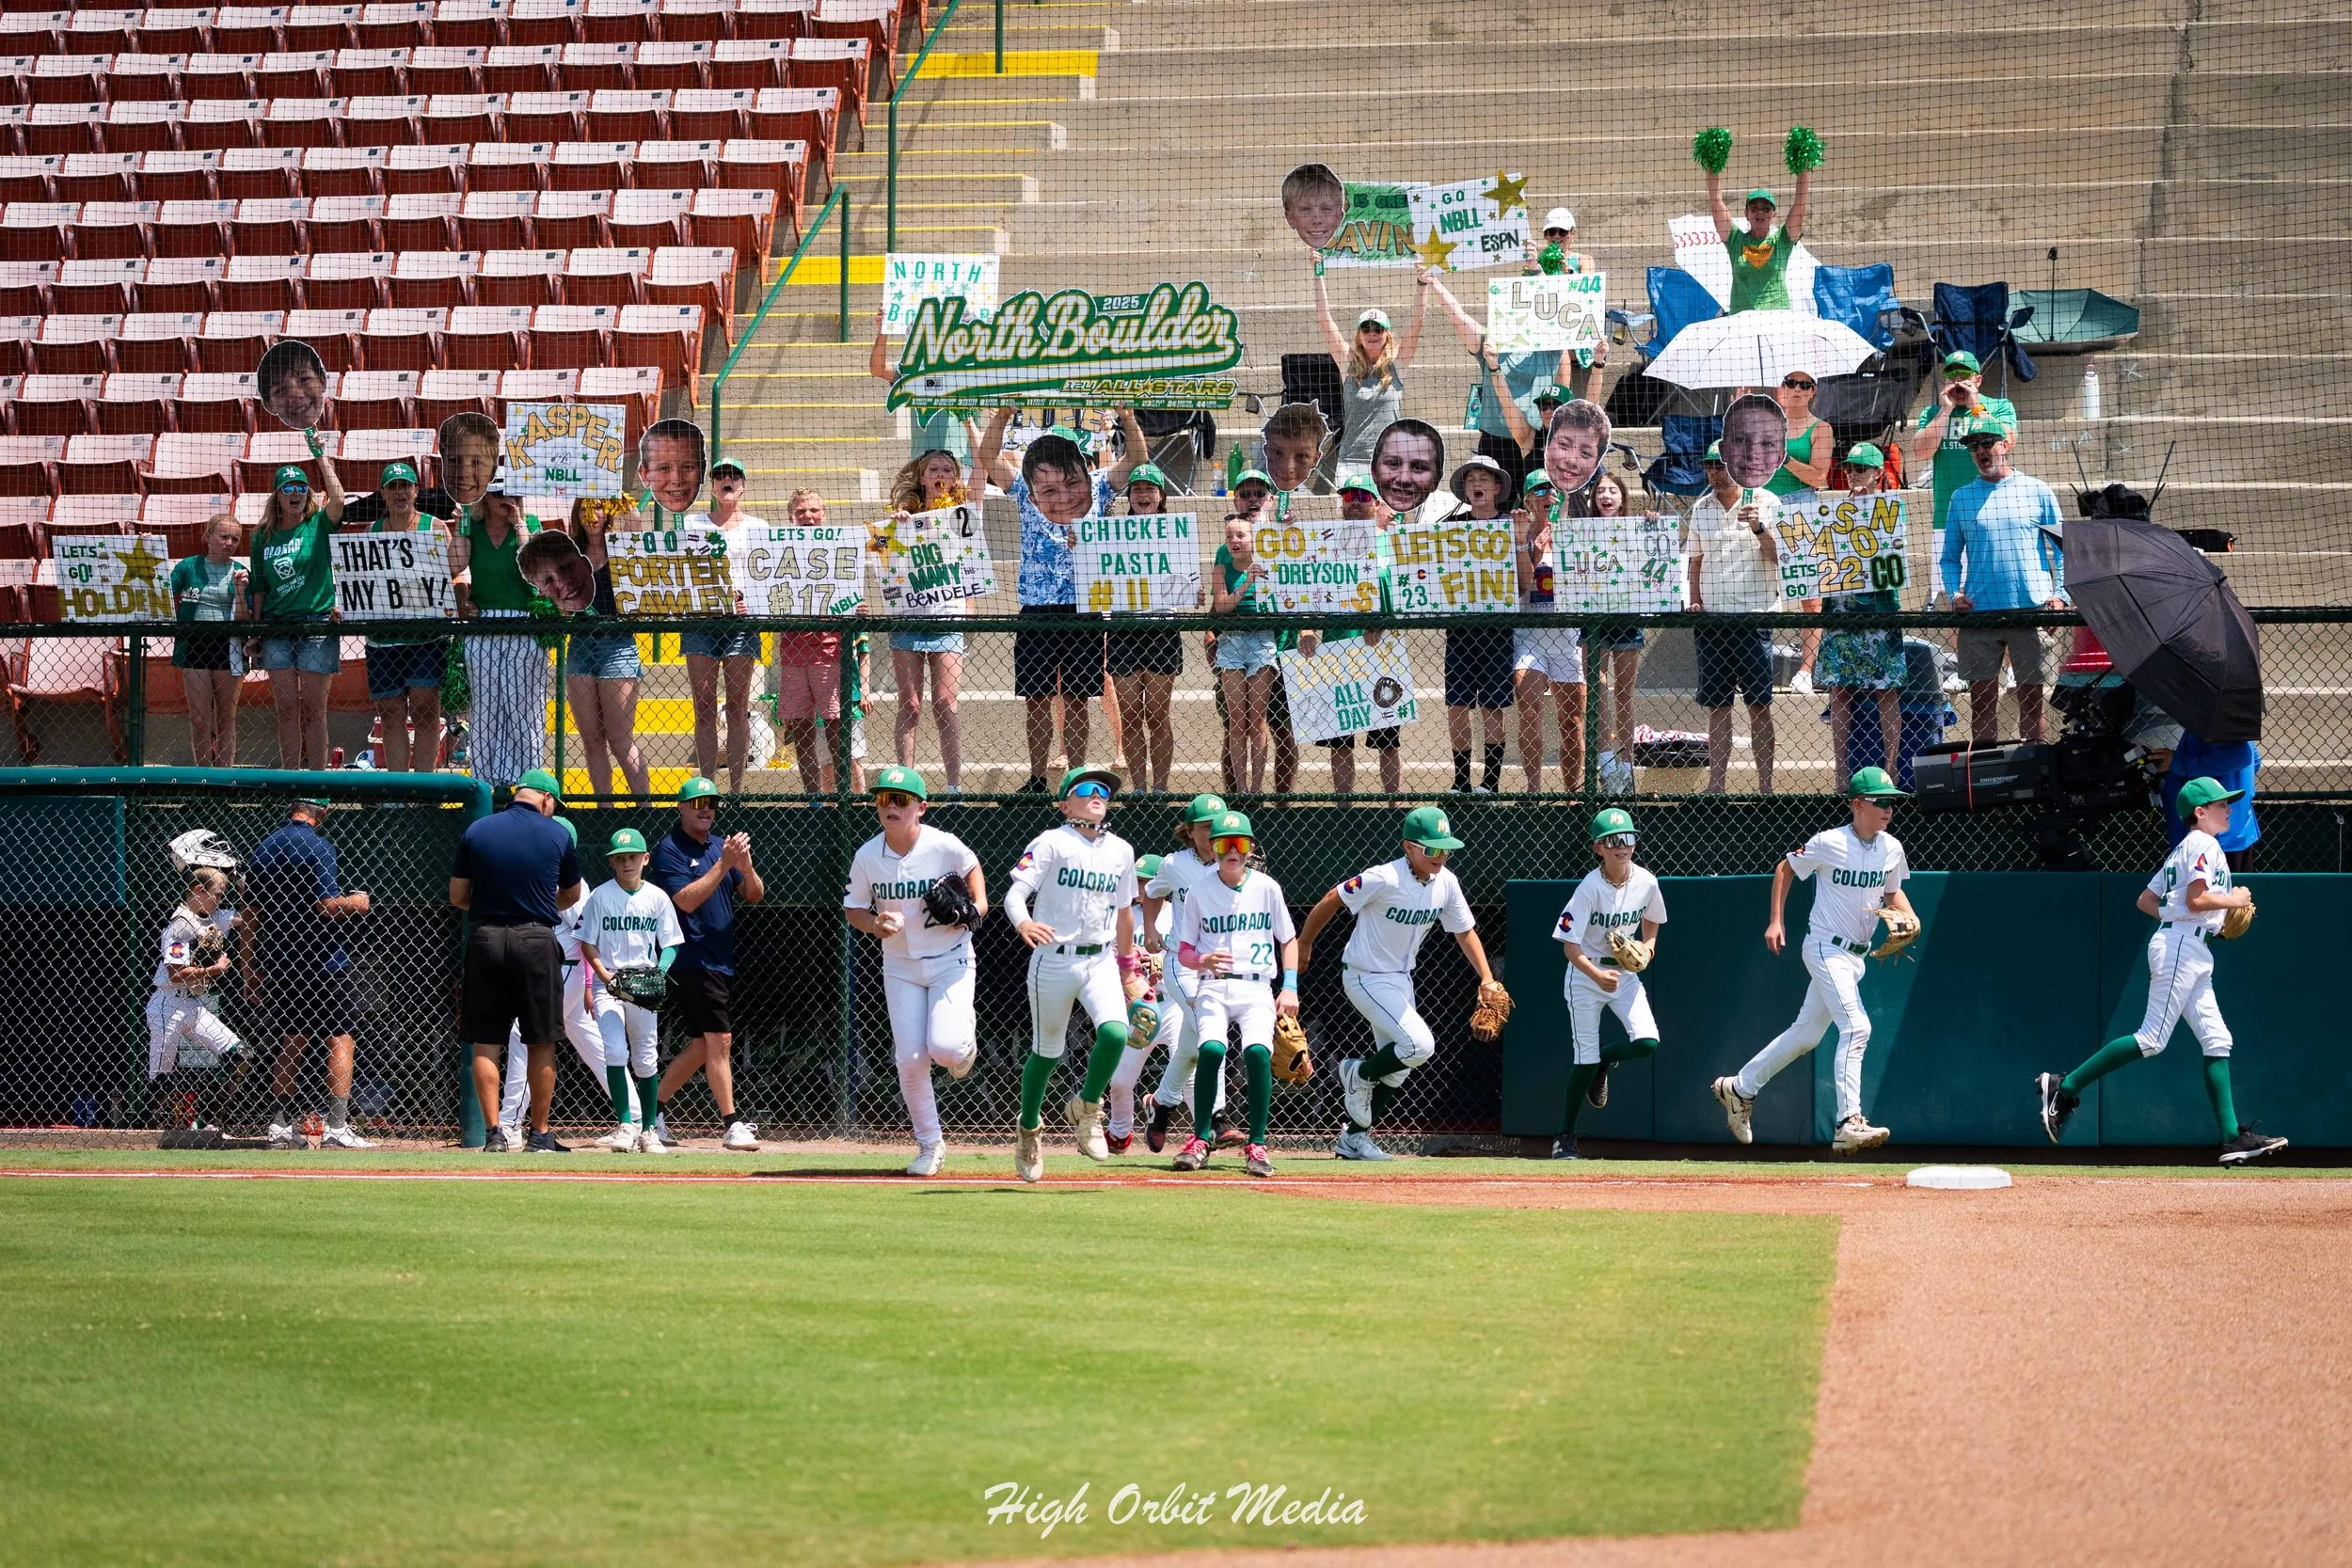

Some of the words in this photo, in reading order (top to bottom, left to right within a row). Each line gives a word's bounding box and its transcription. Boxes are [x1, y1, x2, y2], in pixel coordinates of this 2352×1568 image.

[1441, 190, 1465, 205] GO
[1438, 207, 1483, 235] NBLL
[1325, 220, 1417, 256] AVIN
[1480, 229, 1519, 253] ESPN
[894, 260, 982, 283] NORTH
[1568, 276, 1601, 294] #44
[1103, 294, 1140, 311] 2025
[1511, 281, 1601, 341] LUCA
[902, 290, 1041, 368] North
[1040, 284, 1235, 360] Boulder
[505, 404, 623, 474] KASPER
[545, 467, 582, 483] NBLL
[813, 528, 844, 542] GO!
[955, 506, 974, 538] 2
[1081, 516, 1189, 543] CHICKEN
[1776, 497, 1900, 561] MASON
[339, 537, 415, 573] THAT'S
[643, 531, 678, 554] GO
[910, 542, 945, 569] BIG
[1255, 526, 1306, 560] GO
[607, 554, 734, 589] PORTER
[748, 546, 858, 581] CASE
[1101, 552, 1171, 575] PASTA
[1278, 562, 1359, 585] DREYSON
[1560, 549, 1621, 576] LUCA
[1781, 564, 1817, 579] LETS
[1817, 556, 1866, 594] 22
[907, 562, 961, 594] MANY
[1440, 568, 1515, 607] FIN!
[56, 584, 173, 619] HOLDEN
[341, 579, 375, 612] MY
[614, 586, 734, 615] CAWLEY
[767, 580, 835, 615] #17
[829, 591, 864, 616] NBLL
[1402, 584, 1429, 610] 23
[1334, 681, 1368, 708] ALL
[1337, 704, 1372, 731] DAY
[1397, 698, 1417, 721] #1
[1201, 912, 1273, 934] COLORADO
[1250, 942, 1273, 966] 22
